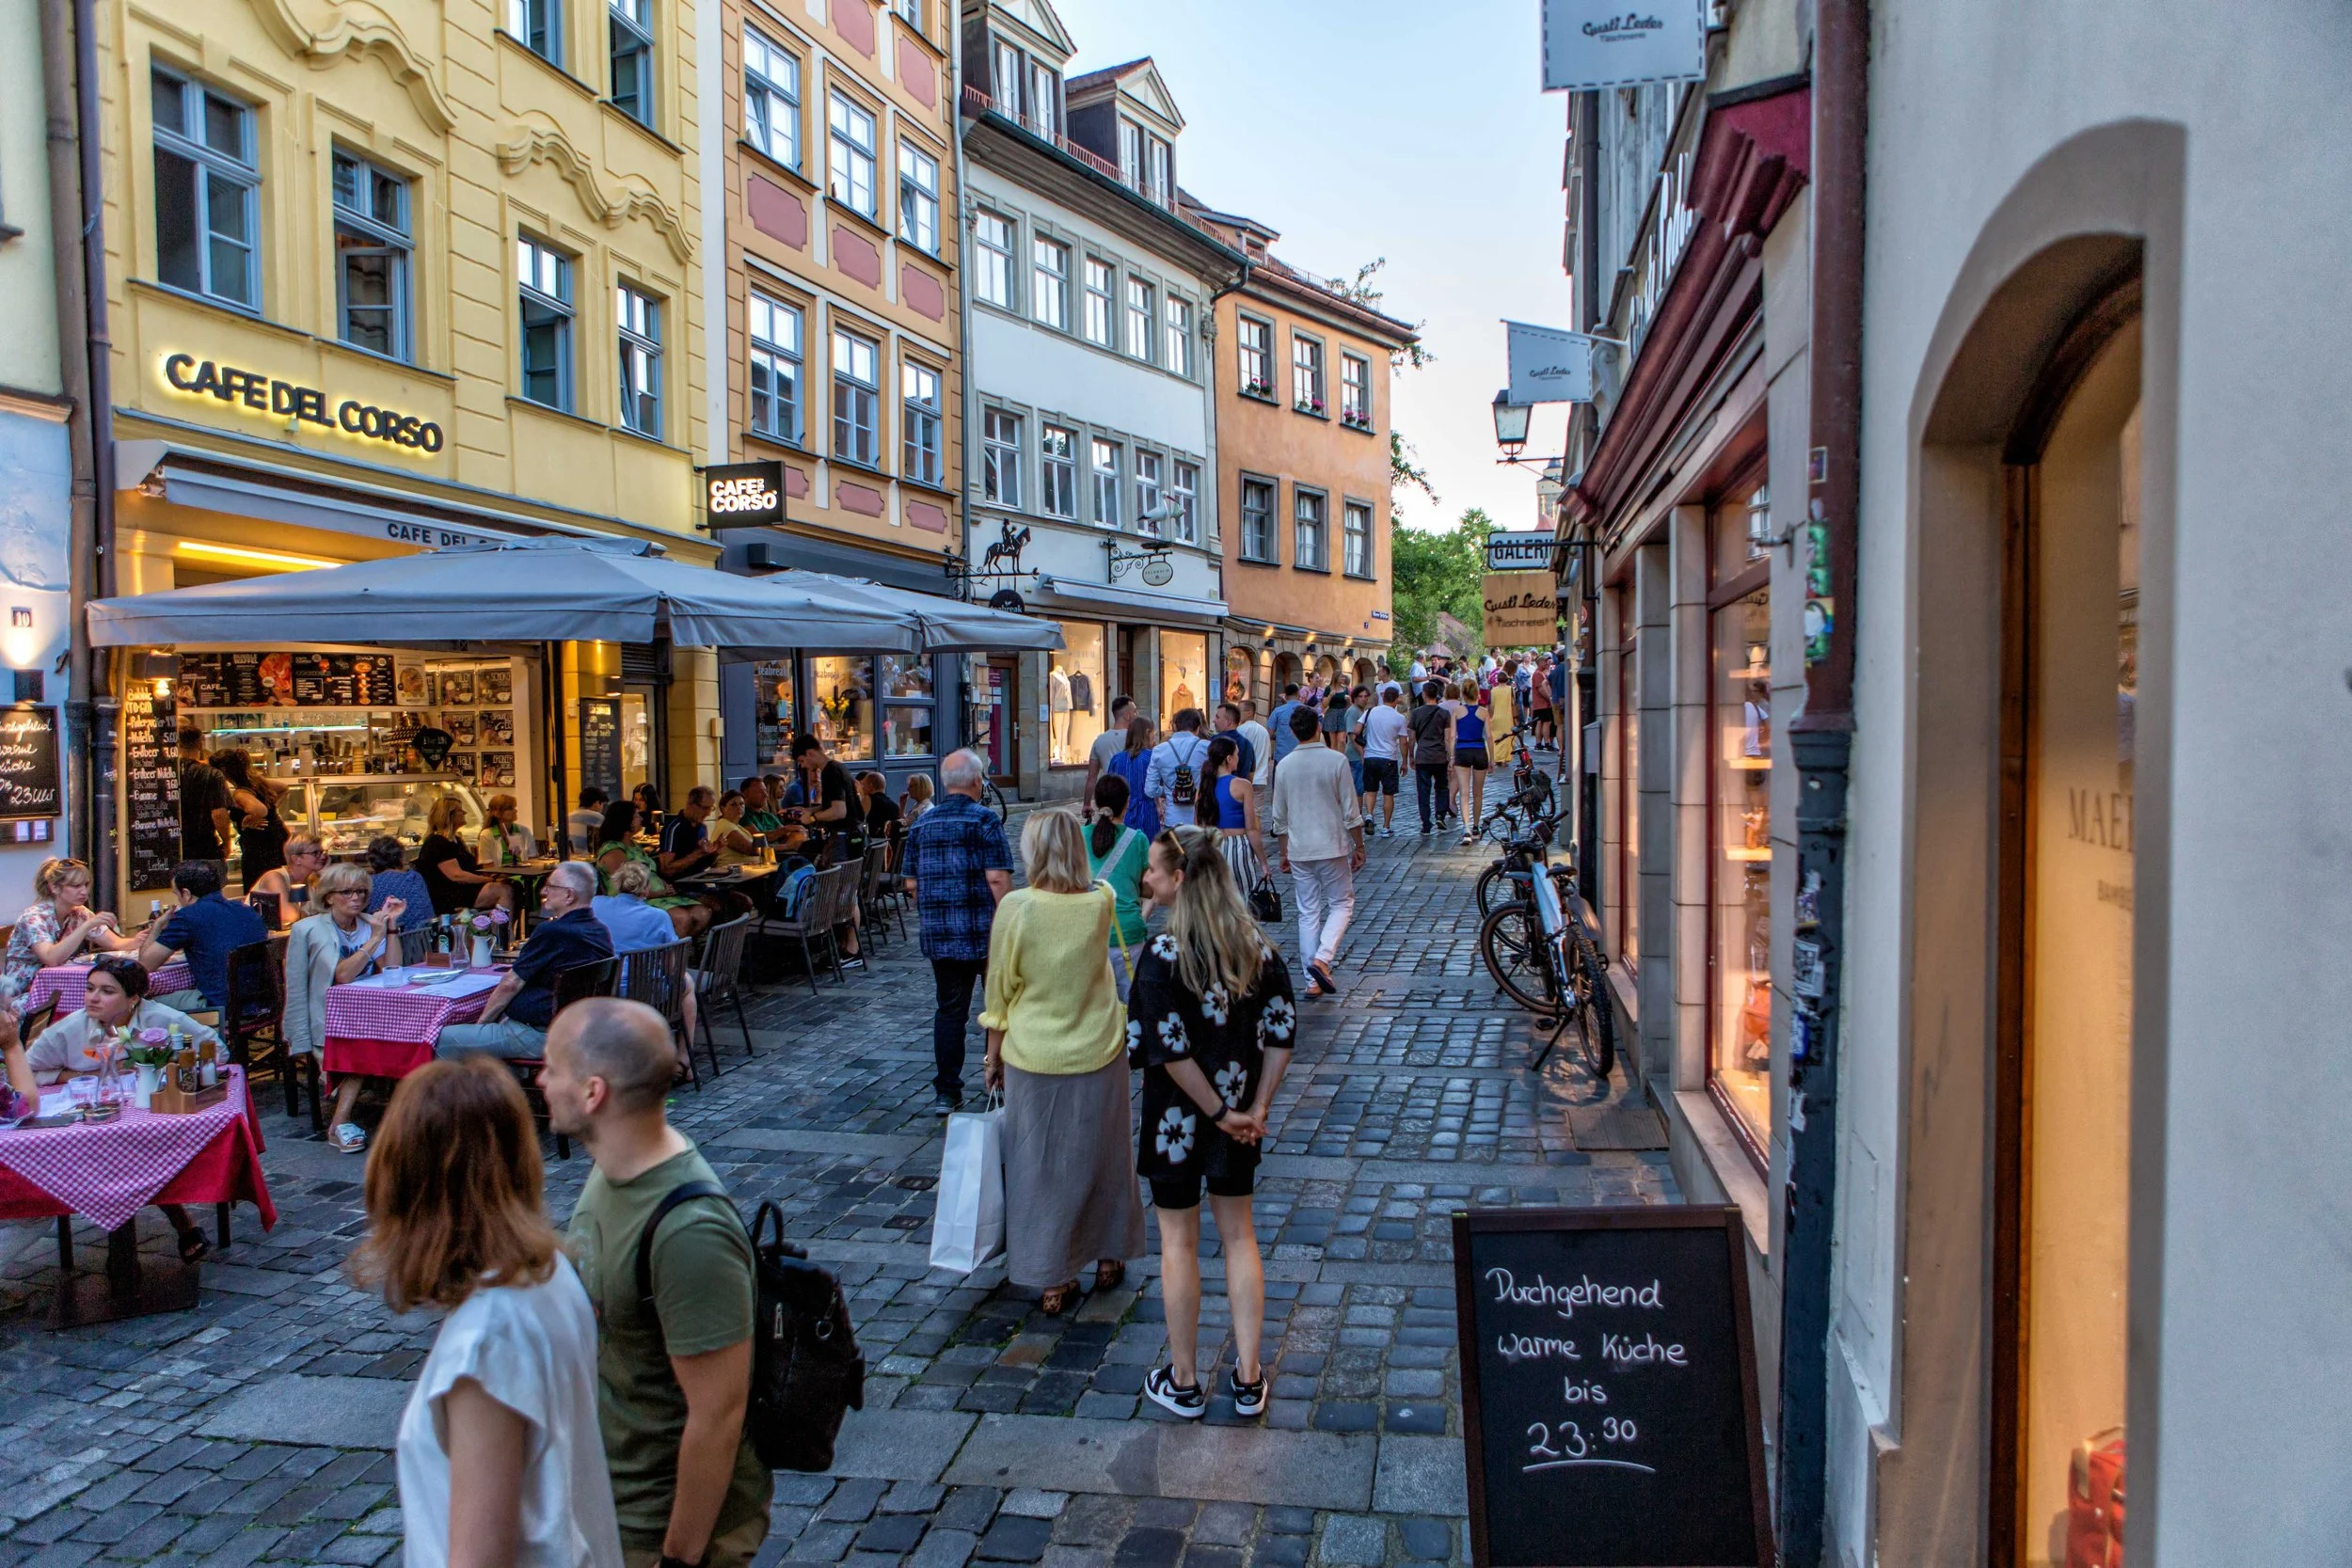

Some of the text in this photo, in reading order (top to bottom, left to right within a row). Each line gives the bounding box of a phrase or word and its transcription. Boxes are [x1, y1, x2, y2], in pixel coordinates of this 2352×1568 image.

[165, 353, 444, 453] CAFE DEL CORSO
[710, 478, 757, 497] CAFE
[711, 491, 777, 513] CORSO
[387, 523, 433, 544] CAFE
[1485, 595, 1518, 611] Gusti
[16, 611, 30, 626] 10
[1486, 1267, 1663, 1317] Durchgehend
[1498, 1333, 1689, 1366] warme Küche
[1564, 1376, 1608, 1404] bis
